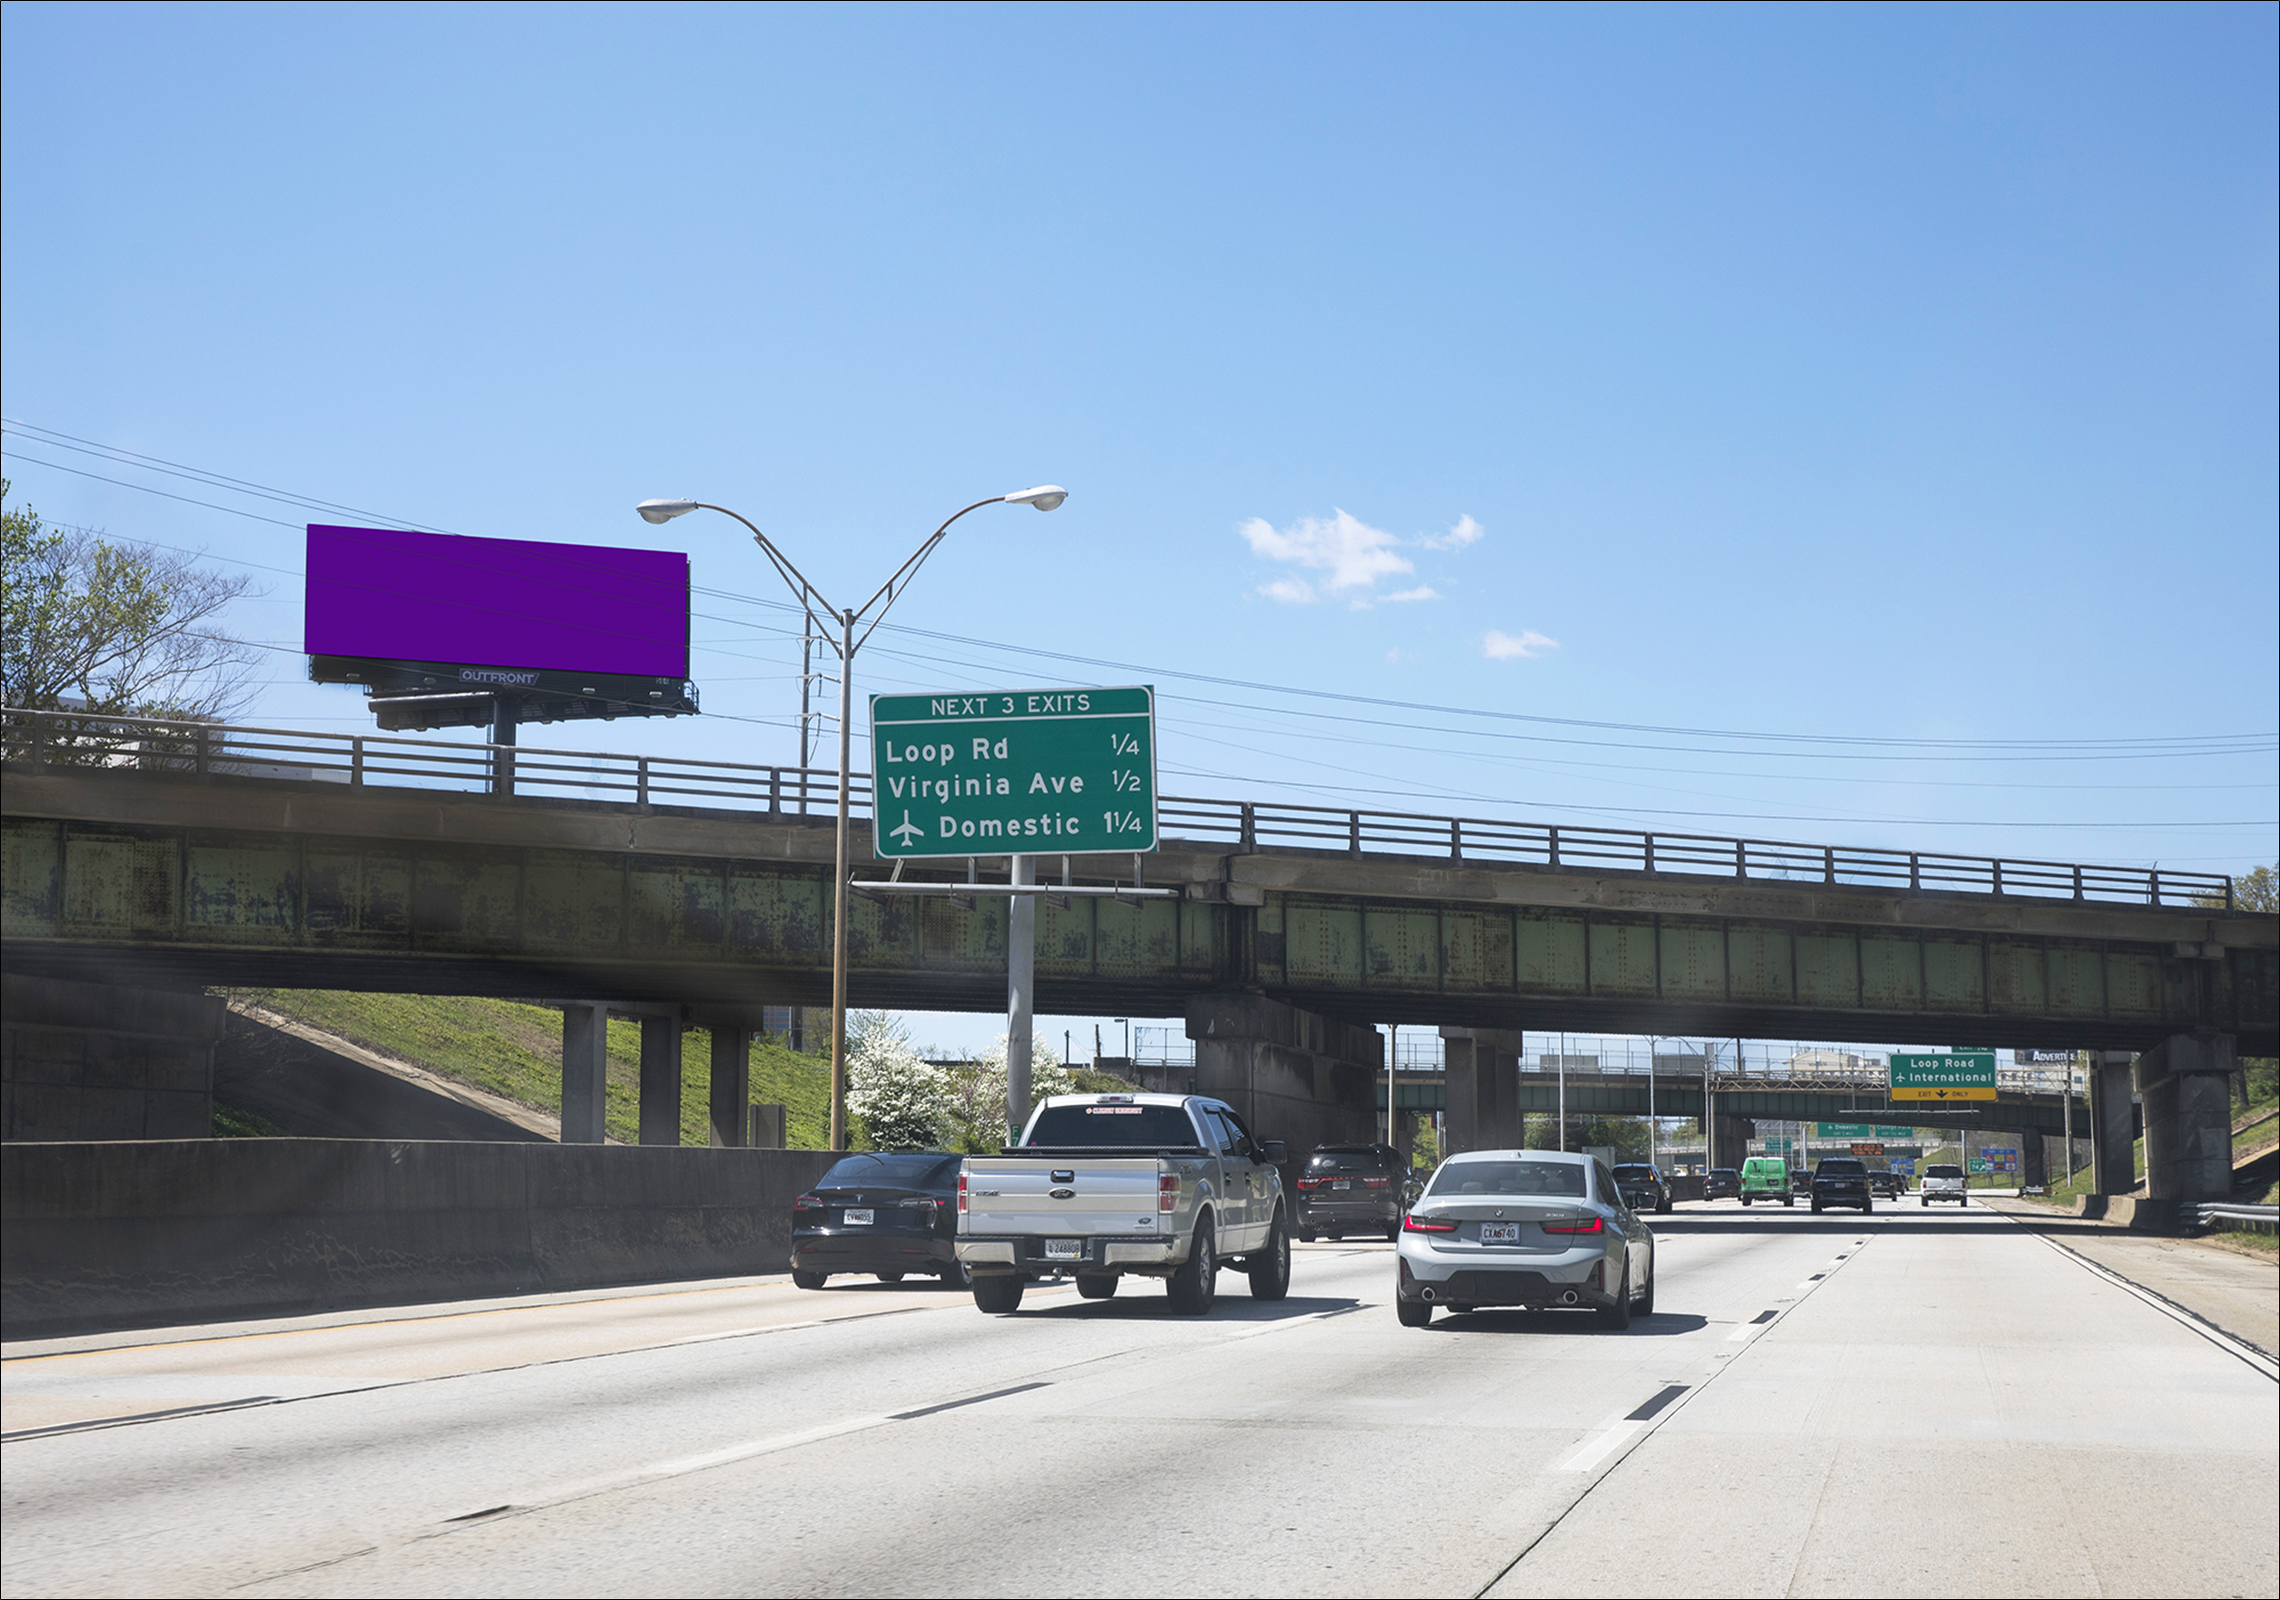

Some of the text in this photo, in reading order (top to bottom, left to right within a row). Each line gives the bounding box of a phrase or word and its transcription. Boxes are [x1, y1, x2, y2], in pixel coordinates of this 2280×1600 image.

[462, 670, 535, 685] OUTFRONT
[931, 694, 1091, 716] NEXT 3 EXITS
[886, 740, 955, 767] Loop
[972, 737, 1009, 760] Rd
[888, 773, 1010, 804] Virginia
[1028, 772, 1084, 794] Ave
[940, 812, 1080, 838] Domestic
[1910, 1058, 1975, 1069] Loop Road
[1909, 1072, 1992, 1082] International
